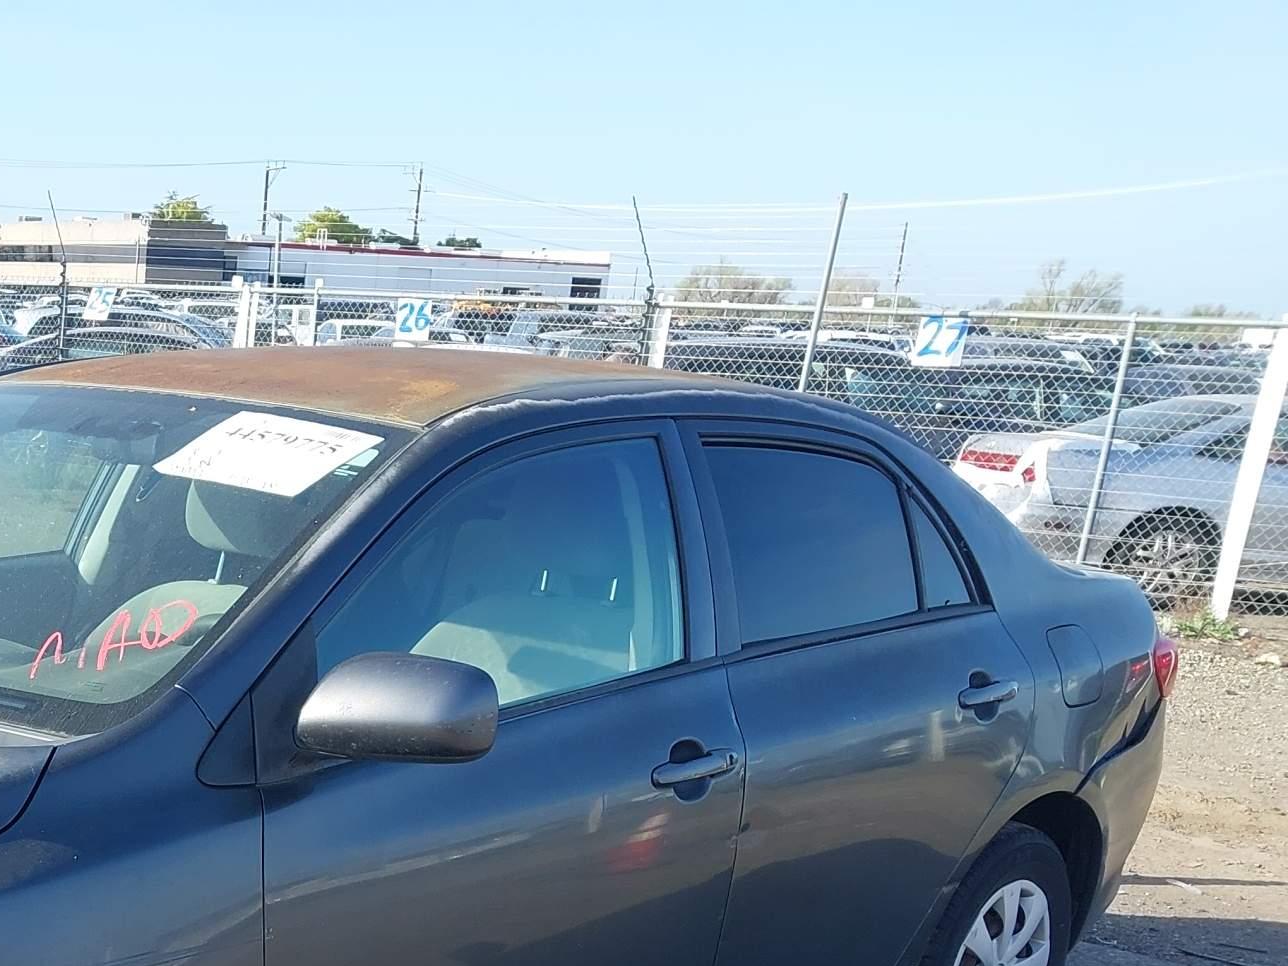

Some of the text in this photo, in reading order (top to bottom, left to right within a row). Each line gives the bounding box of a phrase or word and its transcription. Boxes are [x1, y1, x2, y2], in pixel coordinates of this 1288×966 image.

[398, 300, 430, 332] 26
[916, 315, 969, 357] 27
[225, 427, 345, 456] 44579775
